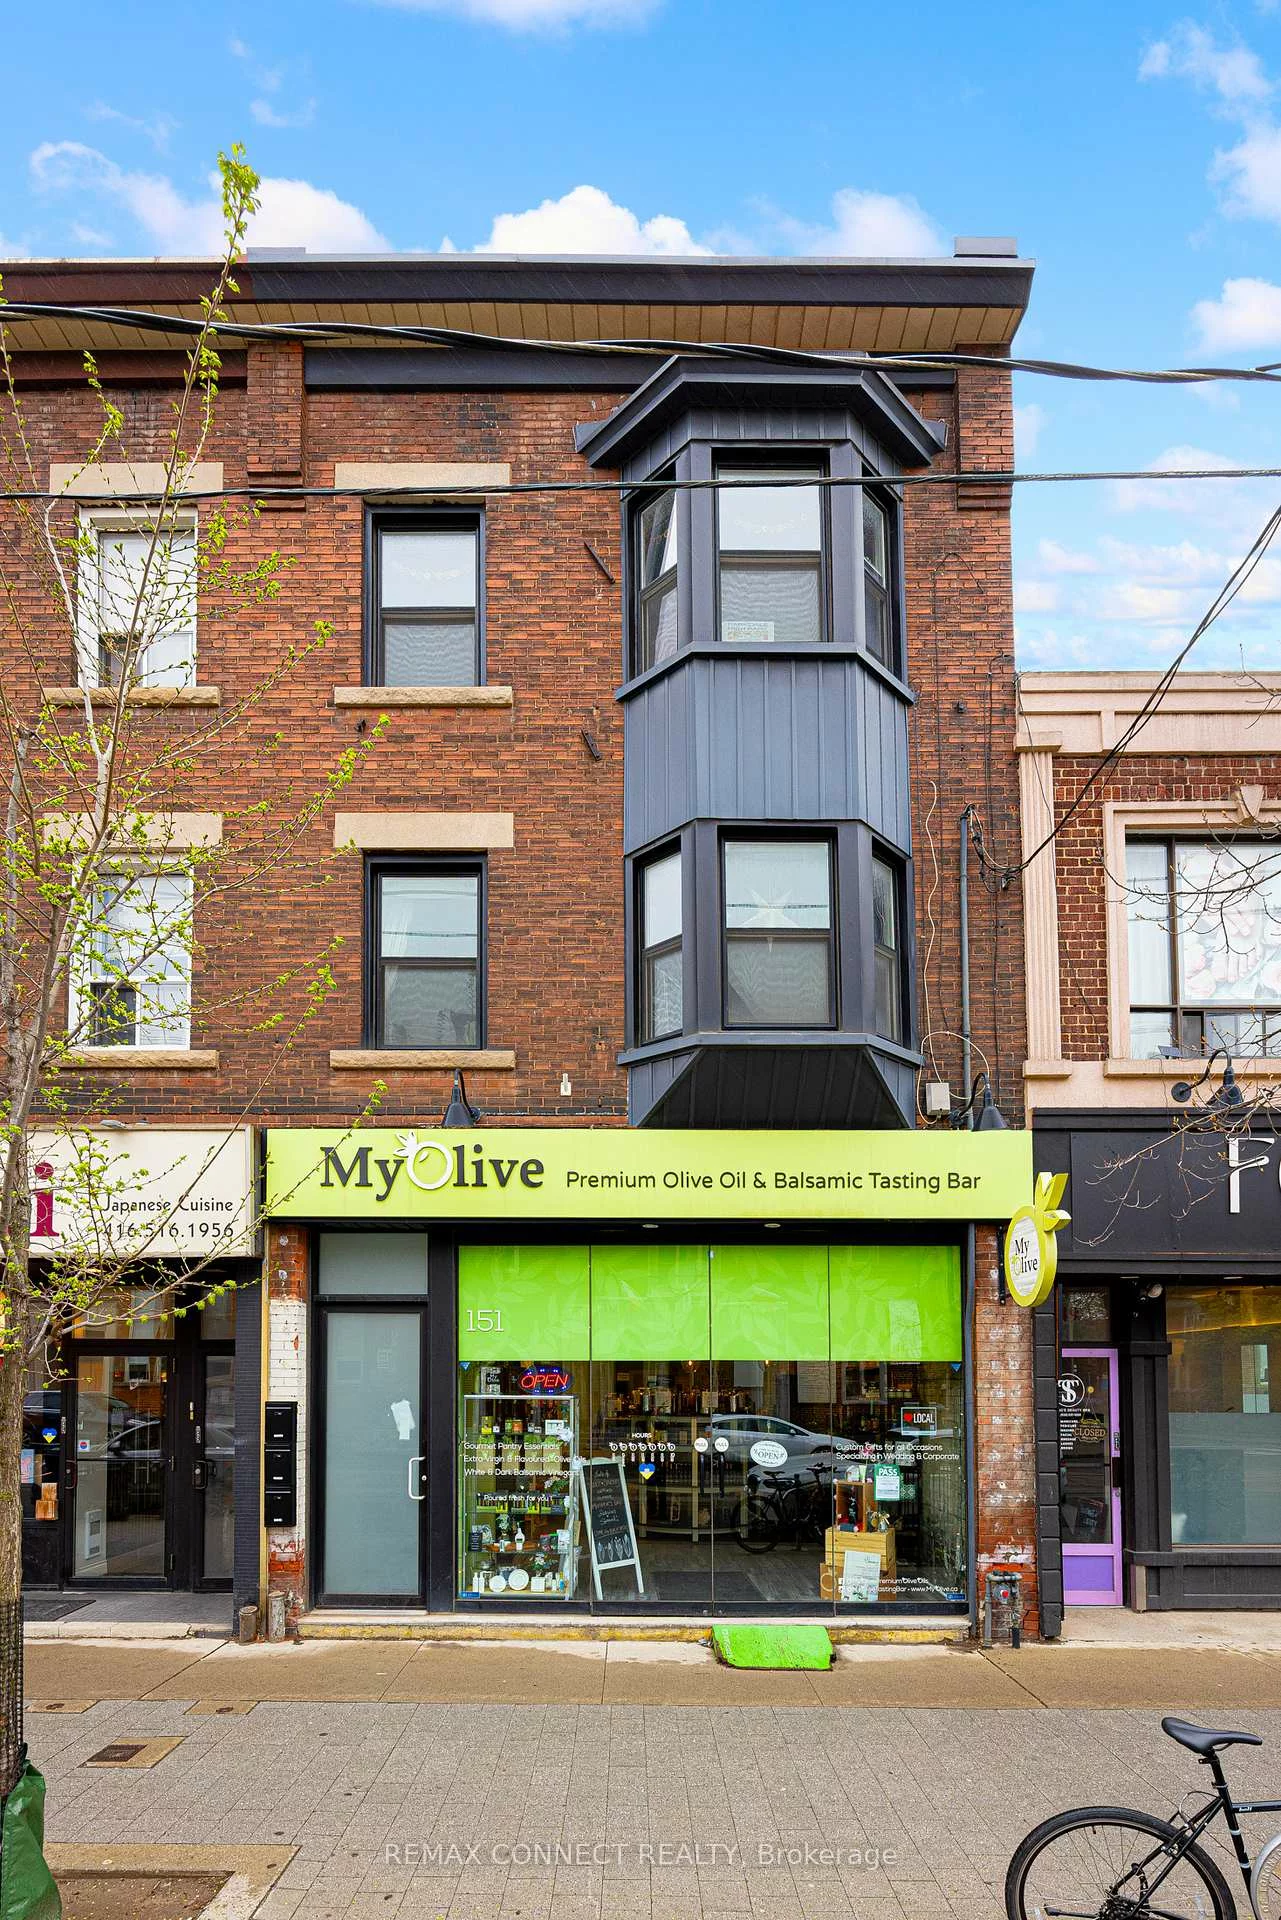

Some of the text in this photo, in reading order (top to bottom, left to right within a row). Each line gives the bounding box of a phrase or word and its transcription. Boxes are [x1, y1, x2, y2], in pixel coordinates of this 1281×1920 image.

[566, 1171, 981, 1193] Premium Olive Oil & Balsamic Tasting Bar
[102, 1198, 233, 1213] Japanese Cuisine
[104, 1223, 235, 1238] 416.516.1956
[1015, 1237, 1030, 1259] My
[1013, 1256, 1038, 1276] Olive
[466, 1309, 504, 1332] 151
[520, 1374, 569, 1388] OPEN
[913, 1413, 934, 1423] LOCAL
[1074, 1427, 1106, 1437] CLOSED
[463, 1442, 496, 1450] Gourmet
[498, 1442, 522, 1451] Pantry
[836, 1443, 863, 1451] Custom
[865, 1442, 882, 1451] Gifts
[884, 1443, 895, 1451] for
[907, 1443, 943, 1451] Occasions
[757, 1451, 780, 1460] OPEN
[836, 1453, 876, 1461] Specializing
[923, 1453, 960, 1461] Corporate
[879, 1468, 898, 1476] PASS
